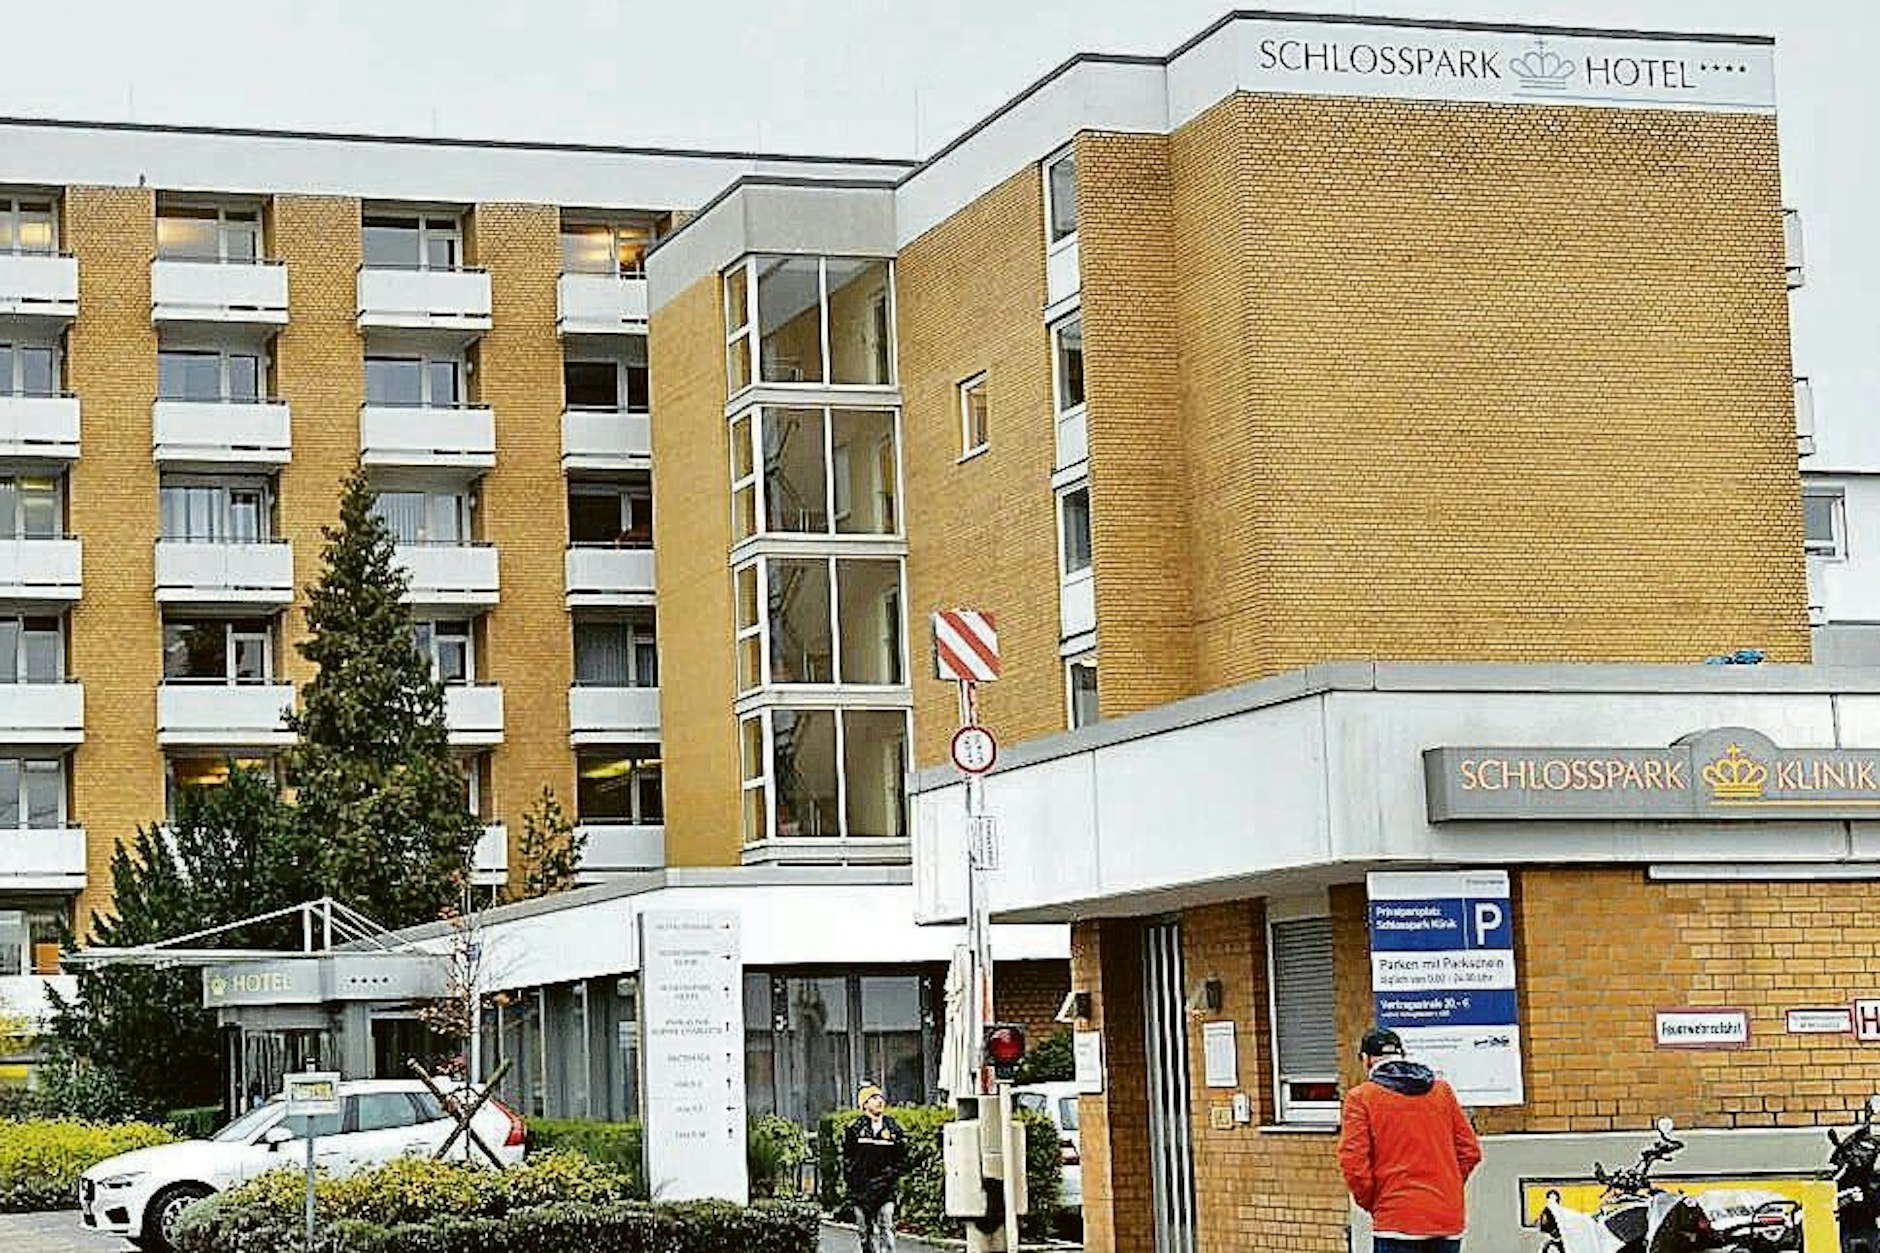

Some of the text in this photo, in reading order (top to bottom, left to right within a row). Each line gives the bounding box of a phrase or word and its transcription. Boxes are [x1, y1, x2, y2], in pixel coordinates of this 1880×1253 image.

[1259, 40, 1697, 89] SCHLOSSPARK HOTEL
[1459, 758, 1879, 791] SCHLOSSPARK KLINIK
[1474, 902, 1503, 946] P
[233, 973, 292, 991] HOTEL
